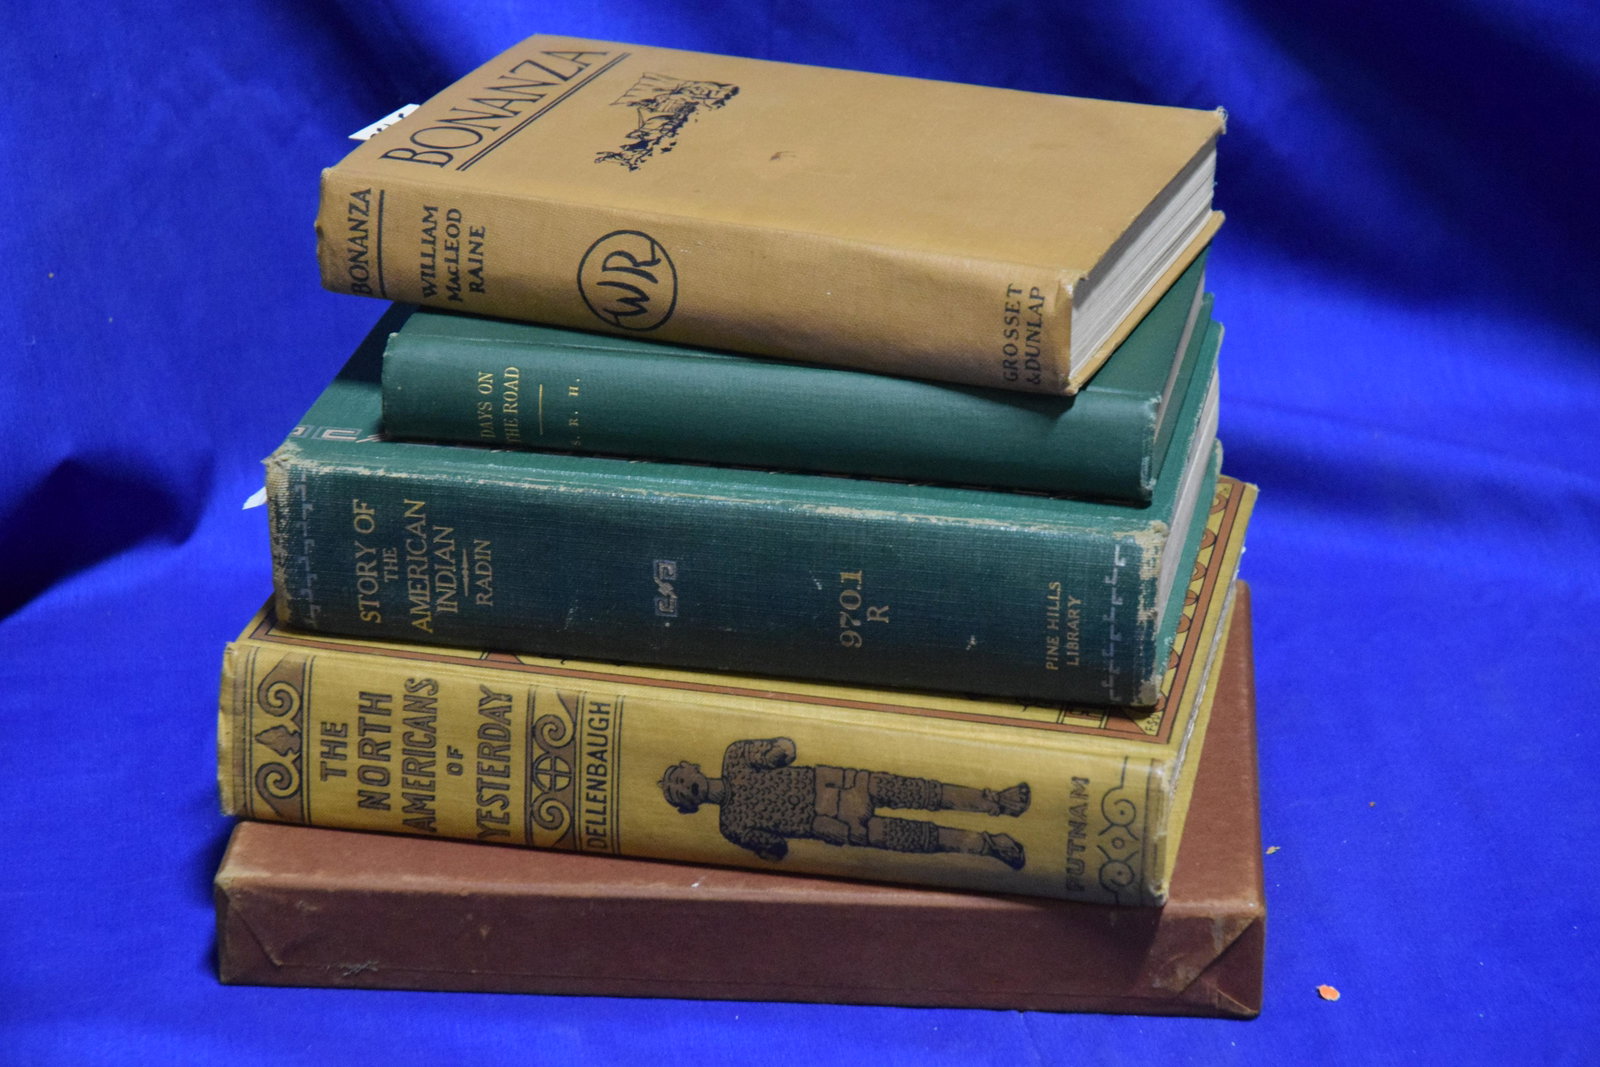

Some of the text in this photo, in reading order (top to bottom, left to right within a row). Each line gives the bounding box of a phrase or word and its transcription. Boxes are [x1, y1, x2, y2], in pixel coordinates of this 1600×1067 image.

[379, 50, 609, 168] BONANZA
[348, 187, 373, 297] BONANZA
[420, 205, 439, 299] WILLIAM
[468, 225, 486, 294] RAINE
[1003, 283, 1022, 382] GROSSET
[478, 371, 496, 439] DAYS ON
[503, 366, 521, 443] THE ROAD
[353, 498, 382, 624] STORY OF
[383, 547, 399, 582] THE
[403, 499, 433, 634] AMERICAN
[432, 525, 458, 613] INDIAN
[473, 539, 494, 607] RADIN
[839, 569, 863, 649] 970.1
[866, 605, 890, 624] R
[1046, 581, 1062, 670] PINE HILLS
[1066, 595, 1082, 666] LIBRARY
[320, 720, 349, 782] THE
[357, 691, 394, 812] NORTH
[402, 677, 439, 834] AMERICANS
[446, 744, 464, 776] OF
[475, 684, 512, 840] YESTERDAY
[586, 700, 612, 850] DELLENBAUGH
[1066, 776, 1091, 892] PUTNAM
